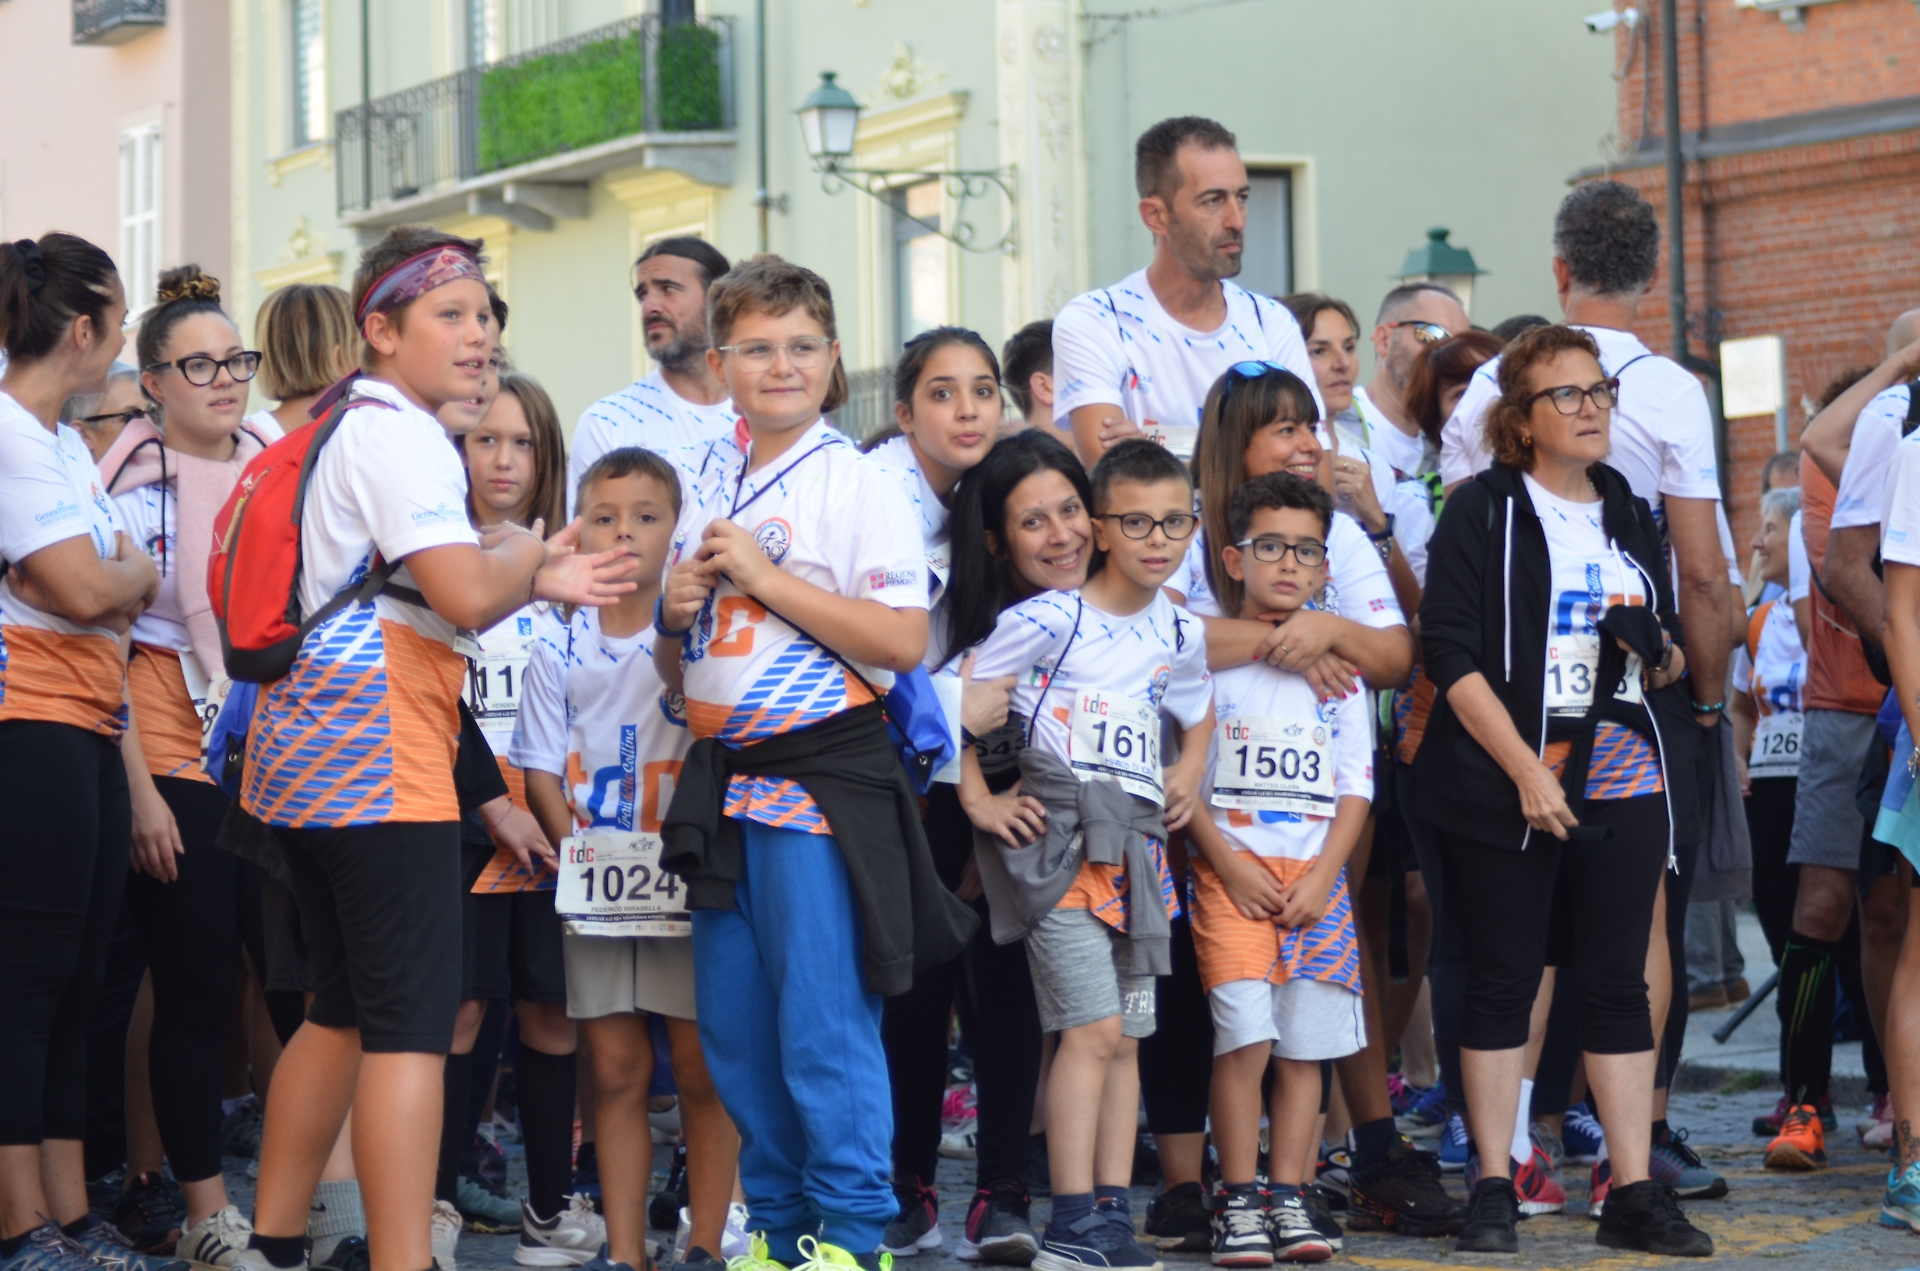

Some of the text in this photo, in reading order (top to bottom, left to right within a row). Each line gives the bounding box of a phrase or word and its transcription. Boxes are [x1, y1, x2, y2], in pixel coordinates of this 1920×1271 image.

[885, 570, 917, 580] REGIONE
[1083, 693, 1108, 716] tdc
[1225, 720, 1249, 741] tdc
[620, 729, 635, 774] Colline
[1235, 744, 1321, 783] 1503
[569, 841, 595, 864] tdc
[580, 864, 679, 902] 1024
[591, 905, 622, 913] FEDERICO
